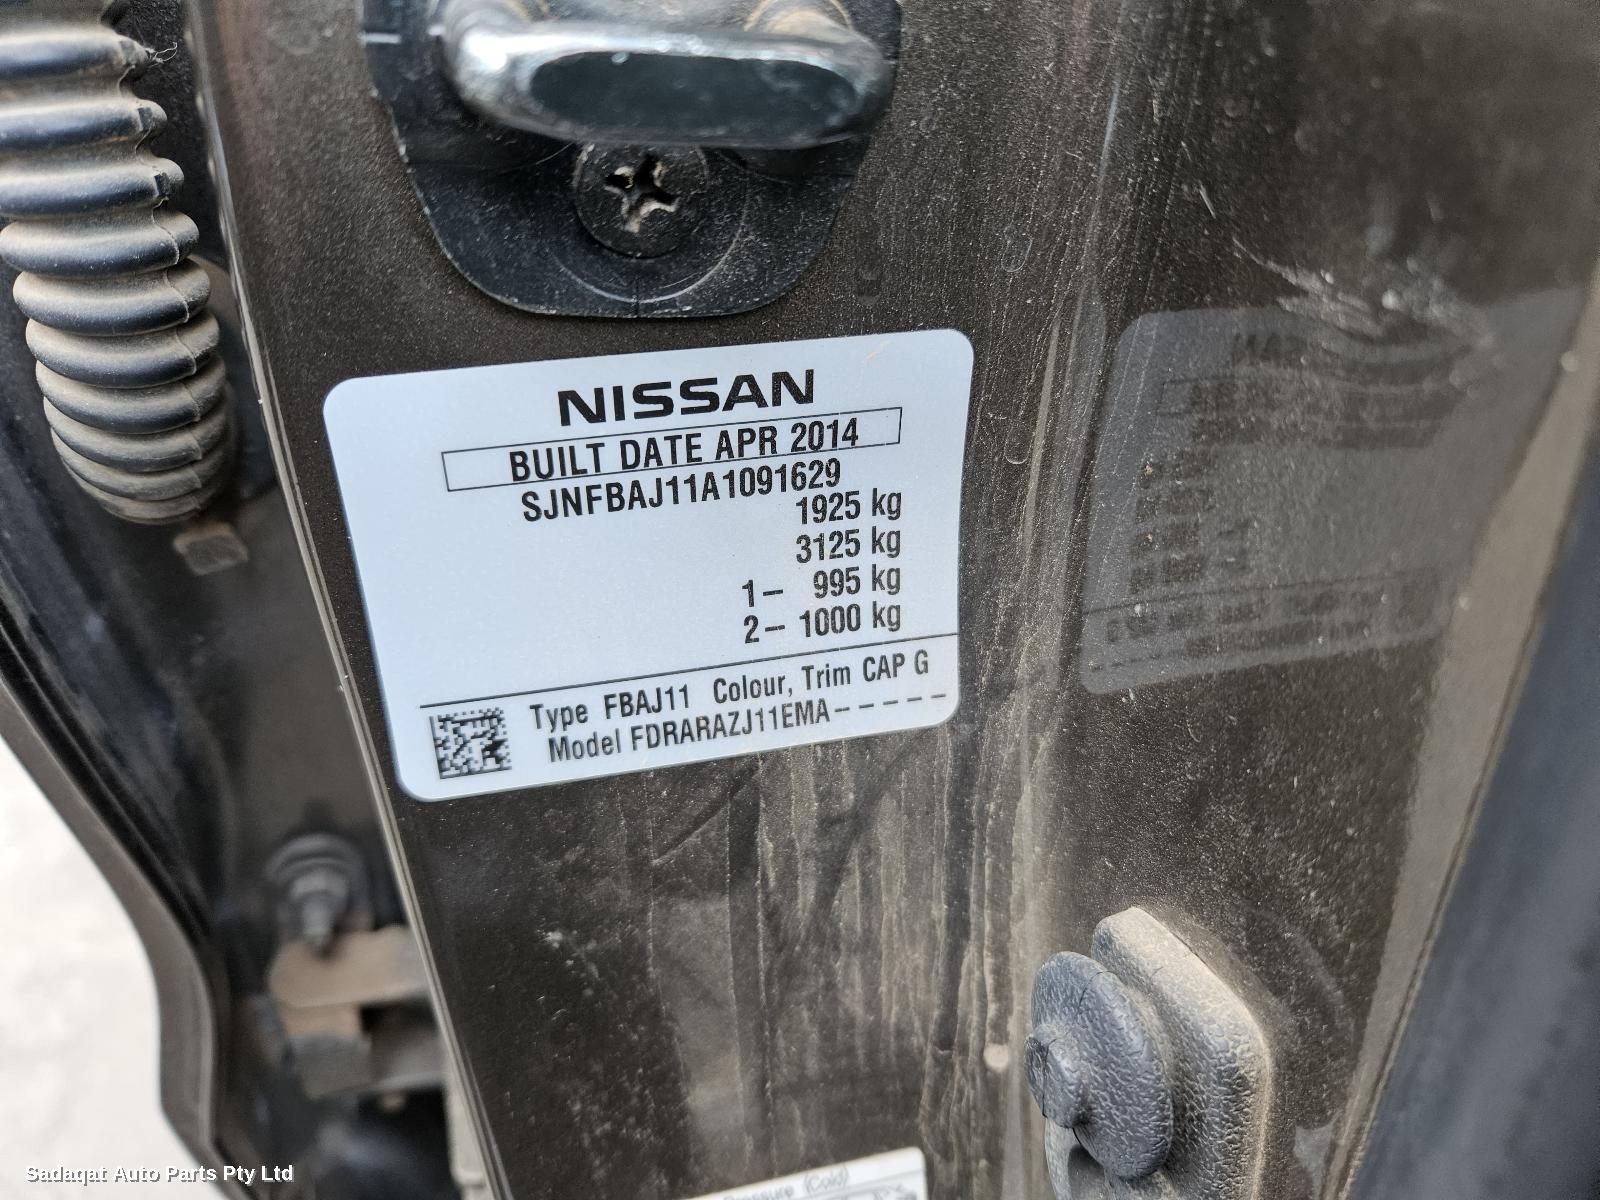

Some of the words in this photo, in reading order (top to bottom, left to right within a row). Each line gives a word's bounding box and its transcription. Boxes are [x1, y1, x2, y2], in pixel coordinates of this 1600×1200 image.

[558, 369, 814, 426] NISSAN
[509, 443, 605, 482] BUILT
[619, 433, 703, 470] DATE
[715, 425, 778, 460] APR
[790, 417, 859, 452] 2014
[521, 457, 841, 522] SJNFBAJ11A1091629
[796, 491, 861, 525] 1925
[872, 488, 902, 521] kg
[796, 529, 861, 564] 3125
[872, 526, 901, 558] kg
[813, 566, 861, 599] 995
[872, 564, 901, 595] kg
[799, 603, 861, 638] 1000
[872, 600, 901, 632] kg
[529, 703, 589, 733] Type
[603, 684, 689, 719] FBAJ11
[713, 674, 793, 704] Colour,
[801, 663, 851, 690] Trim
[862, 652, 906, 682] CAP
[914, 649, 929, 675] G
[548, 727, 622, 763] Model
